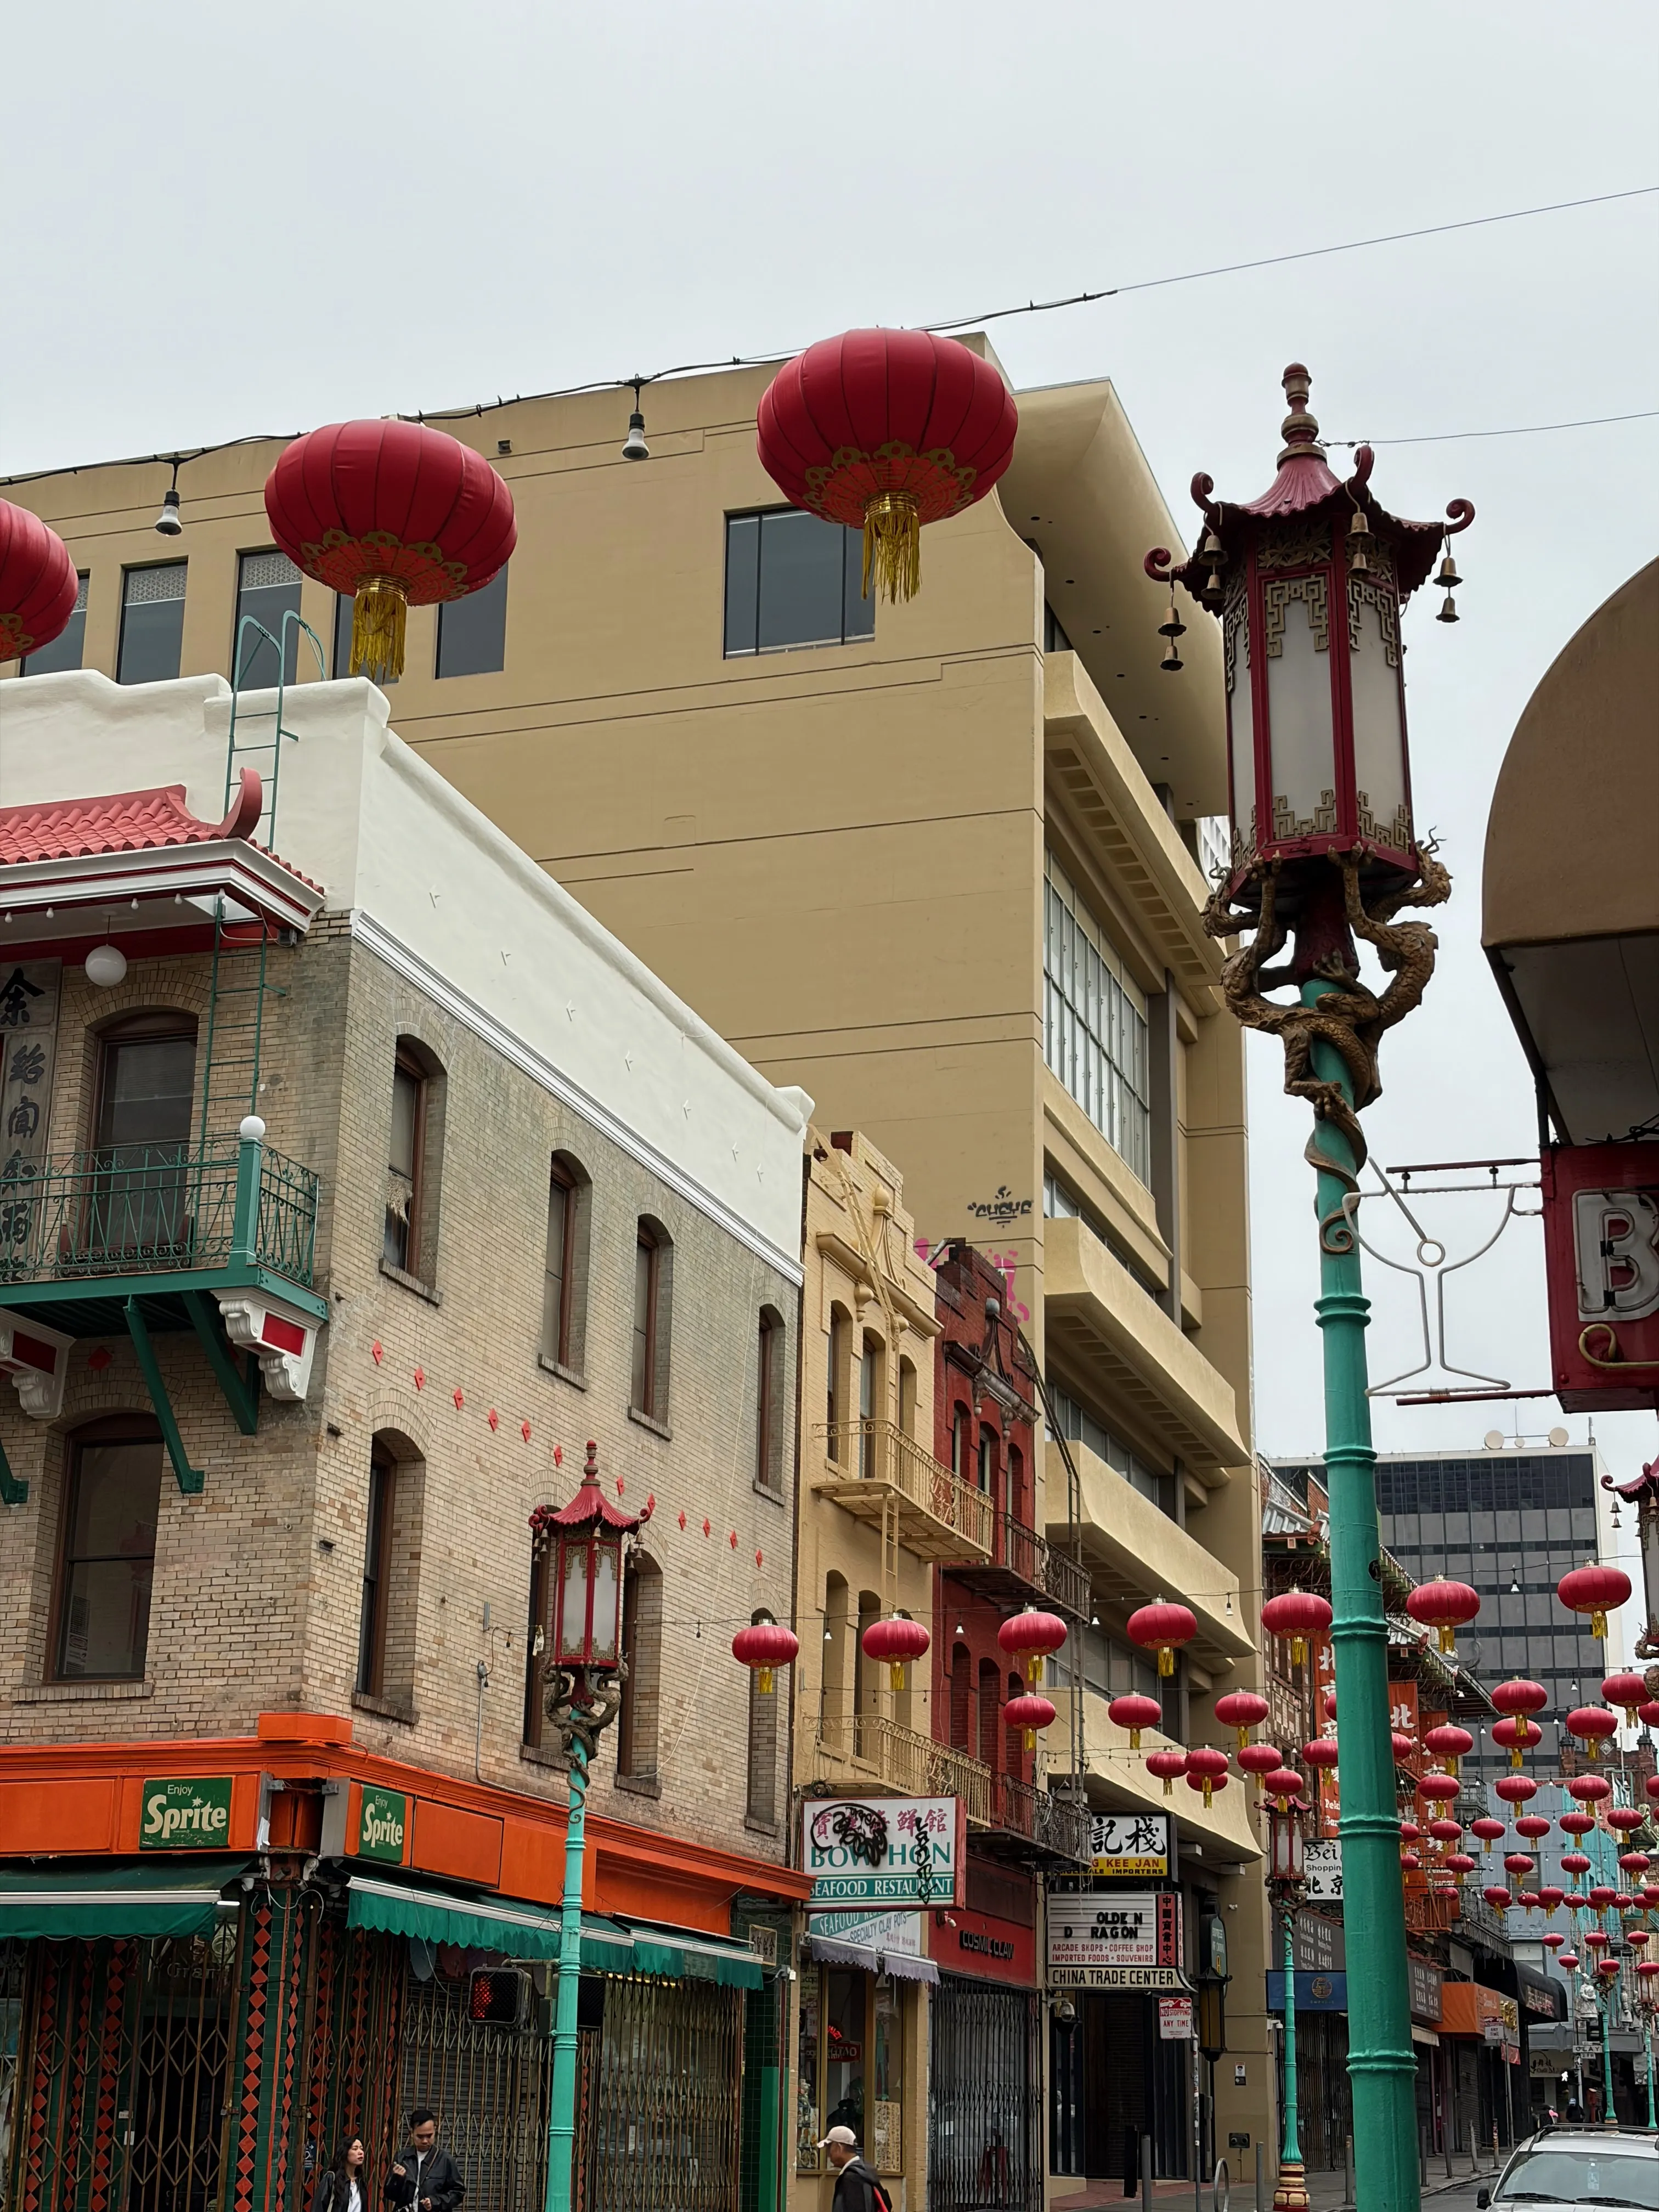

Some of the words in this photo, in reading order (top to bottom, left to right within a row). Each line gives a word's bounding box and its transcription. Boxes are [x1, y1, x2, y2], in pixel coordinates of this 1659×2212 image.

[167, 1784, 193, 1796] Enjoy
[375, 1795, 388, 1809] Enjoy
[144, 1795, 227, 1838] Sprite
[363, 1803, 403, 1848] Sprite
[888, 1842, 951, 1866] HON
[1106, 1859, 1129, 1867] KEE
[1135, 1859, 1159, 1867] JAN
[1306, 1864, 1341, 1872] Shoppin
[874, 1878, 952, 1895] RESTAURANT
[850, 1922, 877, 1943] SPECIALTY
[879, 1917, 892, 1934] CLAY
[894, 1912, 906, 1928] POTS
[961, 1930, 992, 1954] COSMIC
[993, 1939, 1014, 1960] CLAW
[1052, 1944, 1079, 1952] ARCADE
[1109, 1944, 1133, 1952] COFFEE
[1136, 1944, 1153, 1952] SHOP
[1116, 1954, 1153, 1962] SOUVENIRS
[1052, 1970, 1086, 1985] CHINA
[1089, 1970, 1126, 1985] TRADE
[1130, 1970, 1173, 1985] CENTER
[1160, 2008, 1169, 2016] NO
